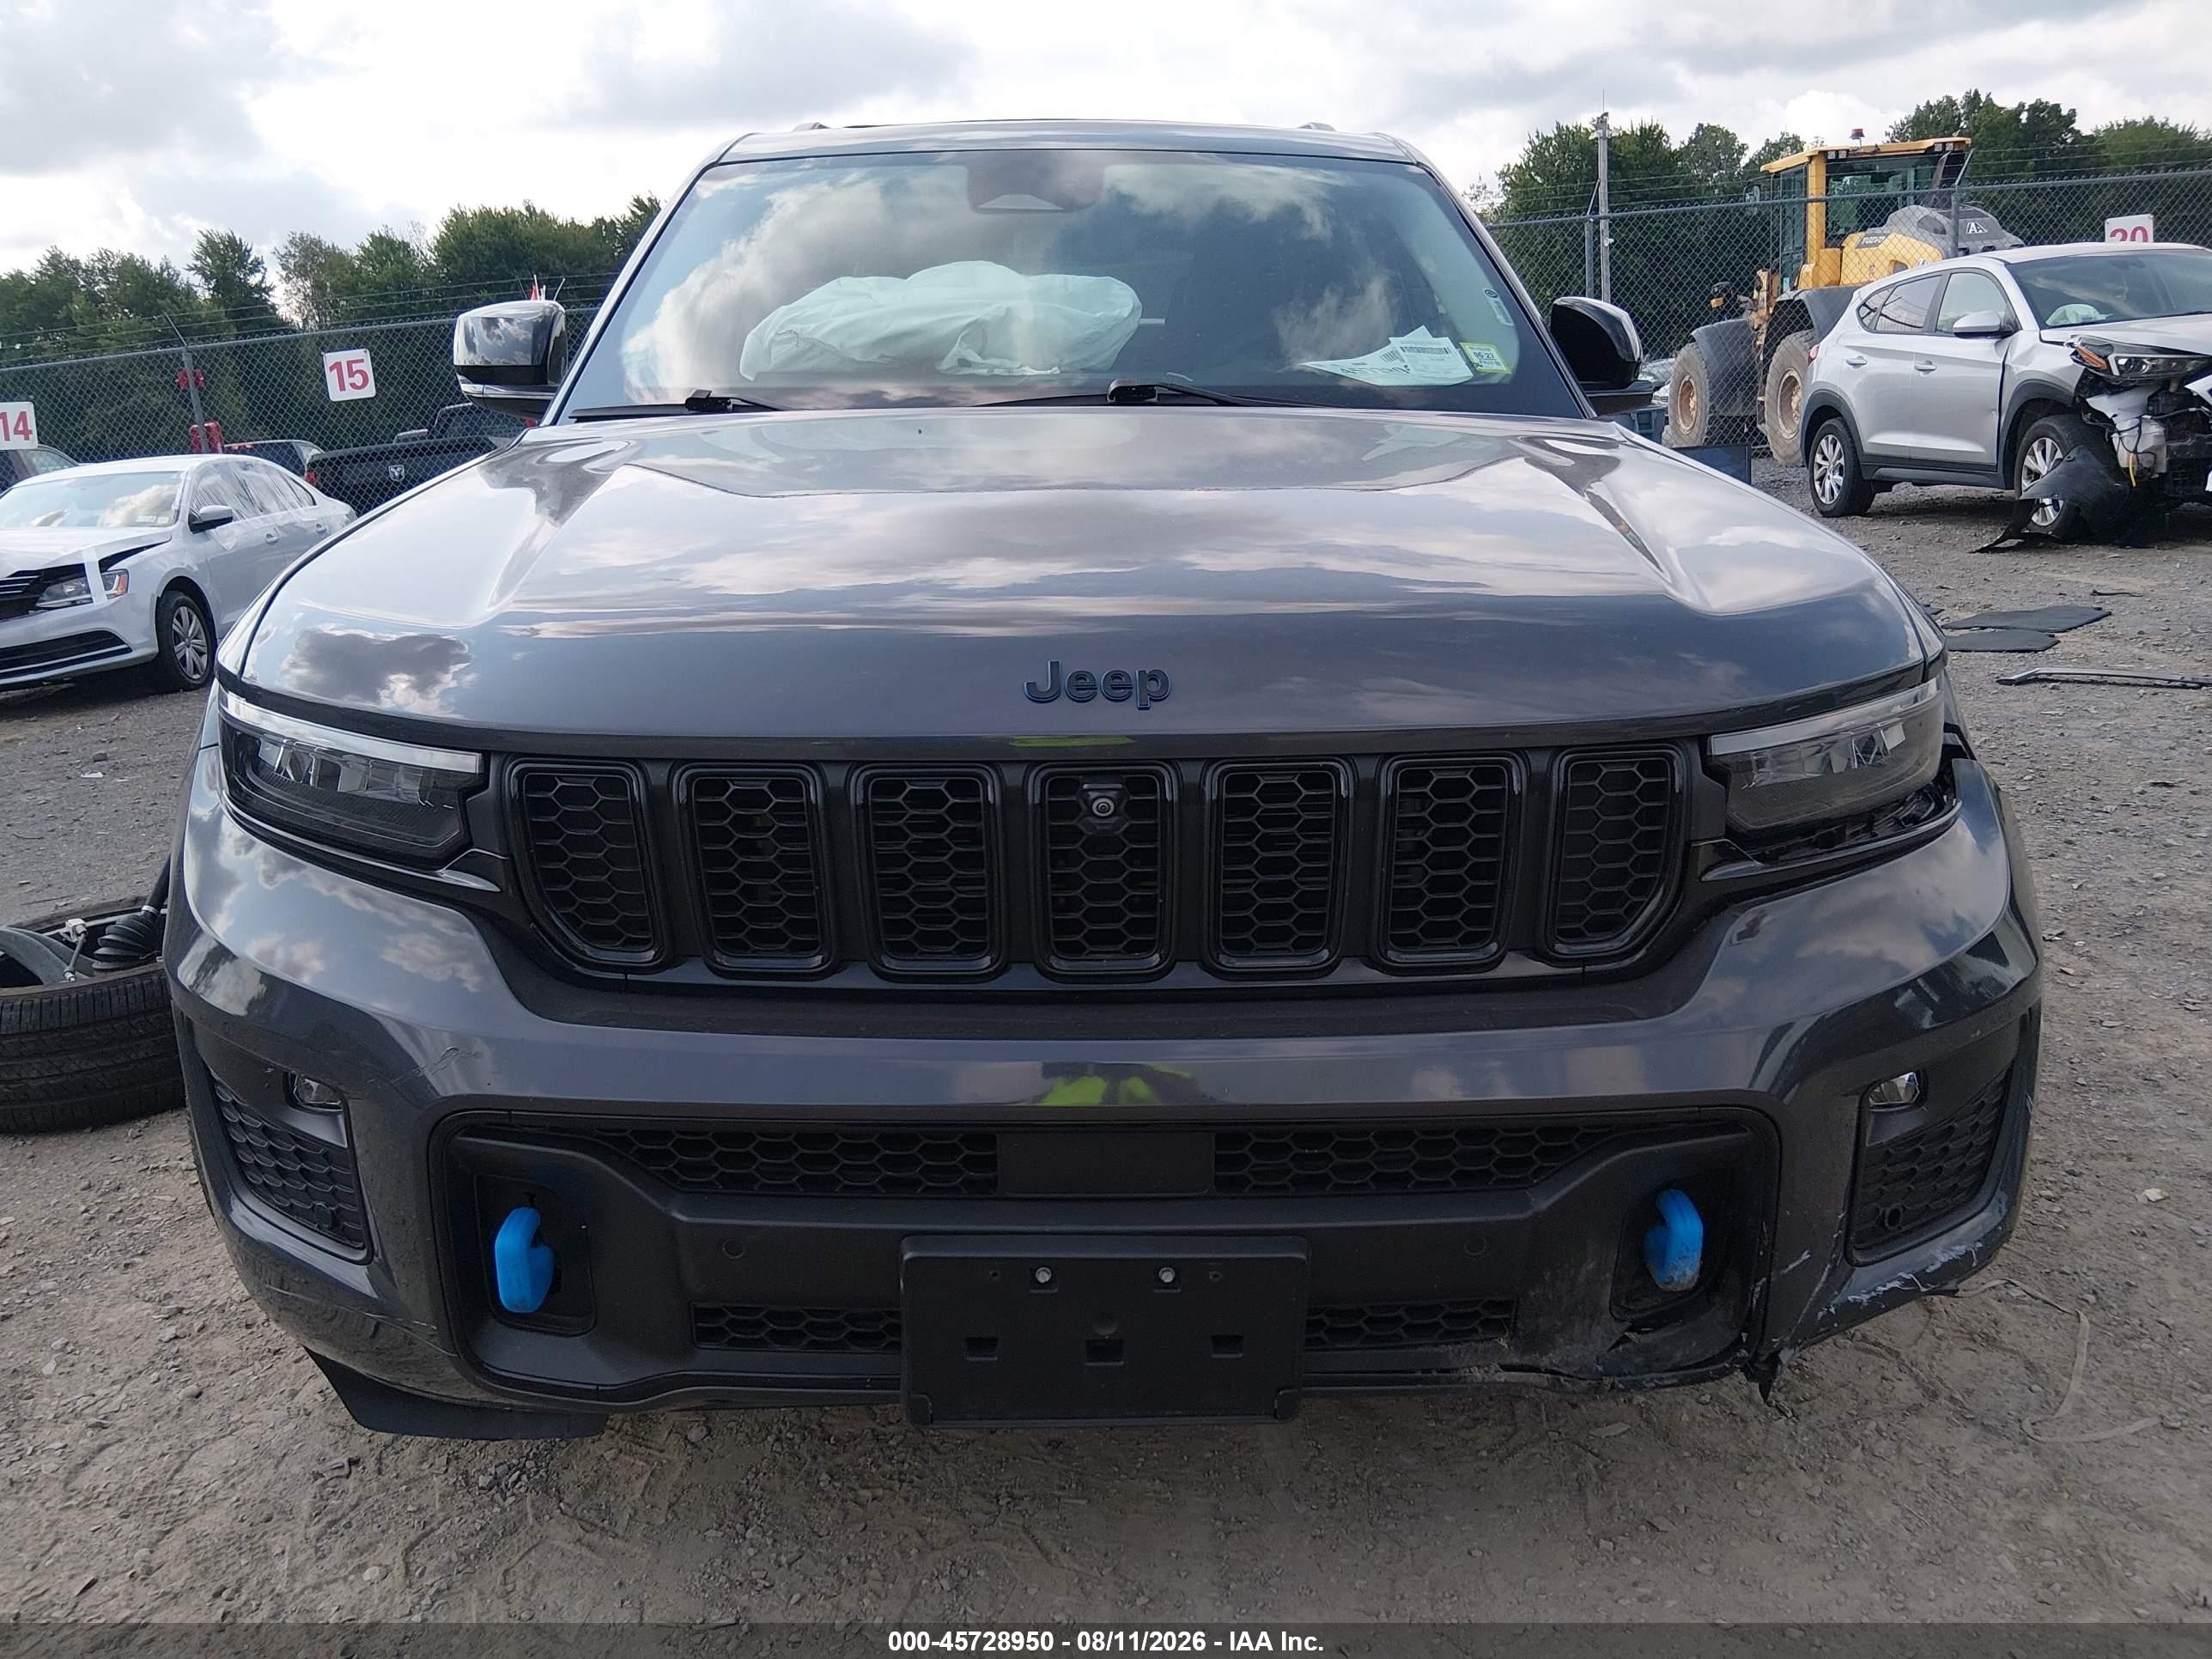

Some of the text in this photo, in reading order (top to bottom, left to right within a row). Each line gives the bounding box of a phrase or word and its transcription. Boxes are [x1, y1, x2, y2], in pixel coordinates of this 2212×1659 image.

[329, 358, 369, 392] 15
[0, 410, 33, 441] 14
[1024, 660, 1170, 710] Jeep
